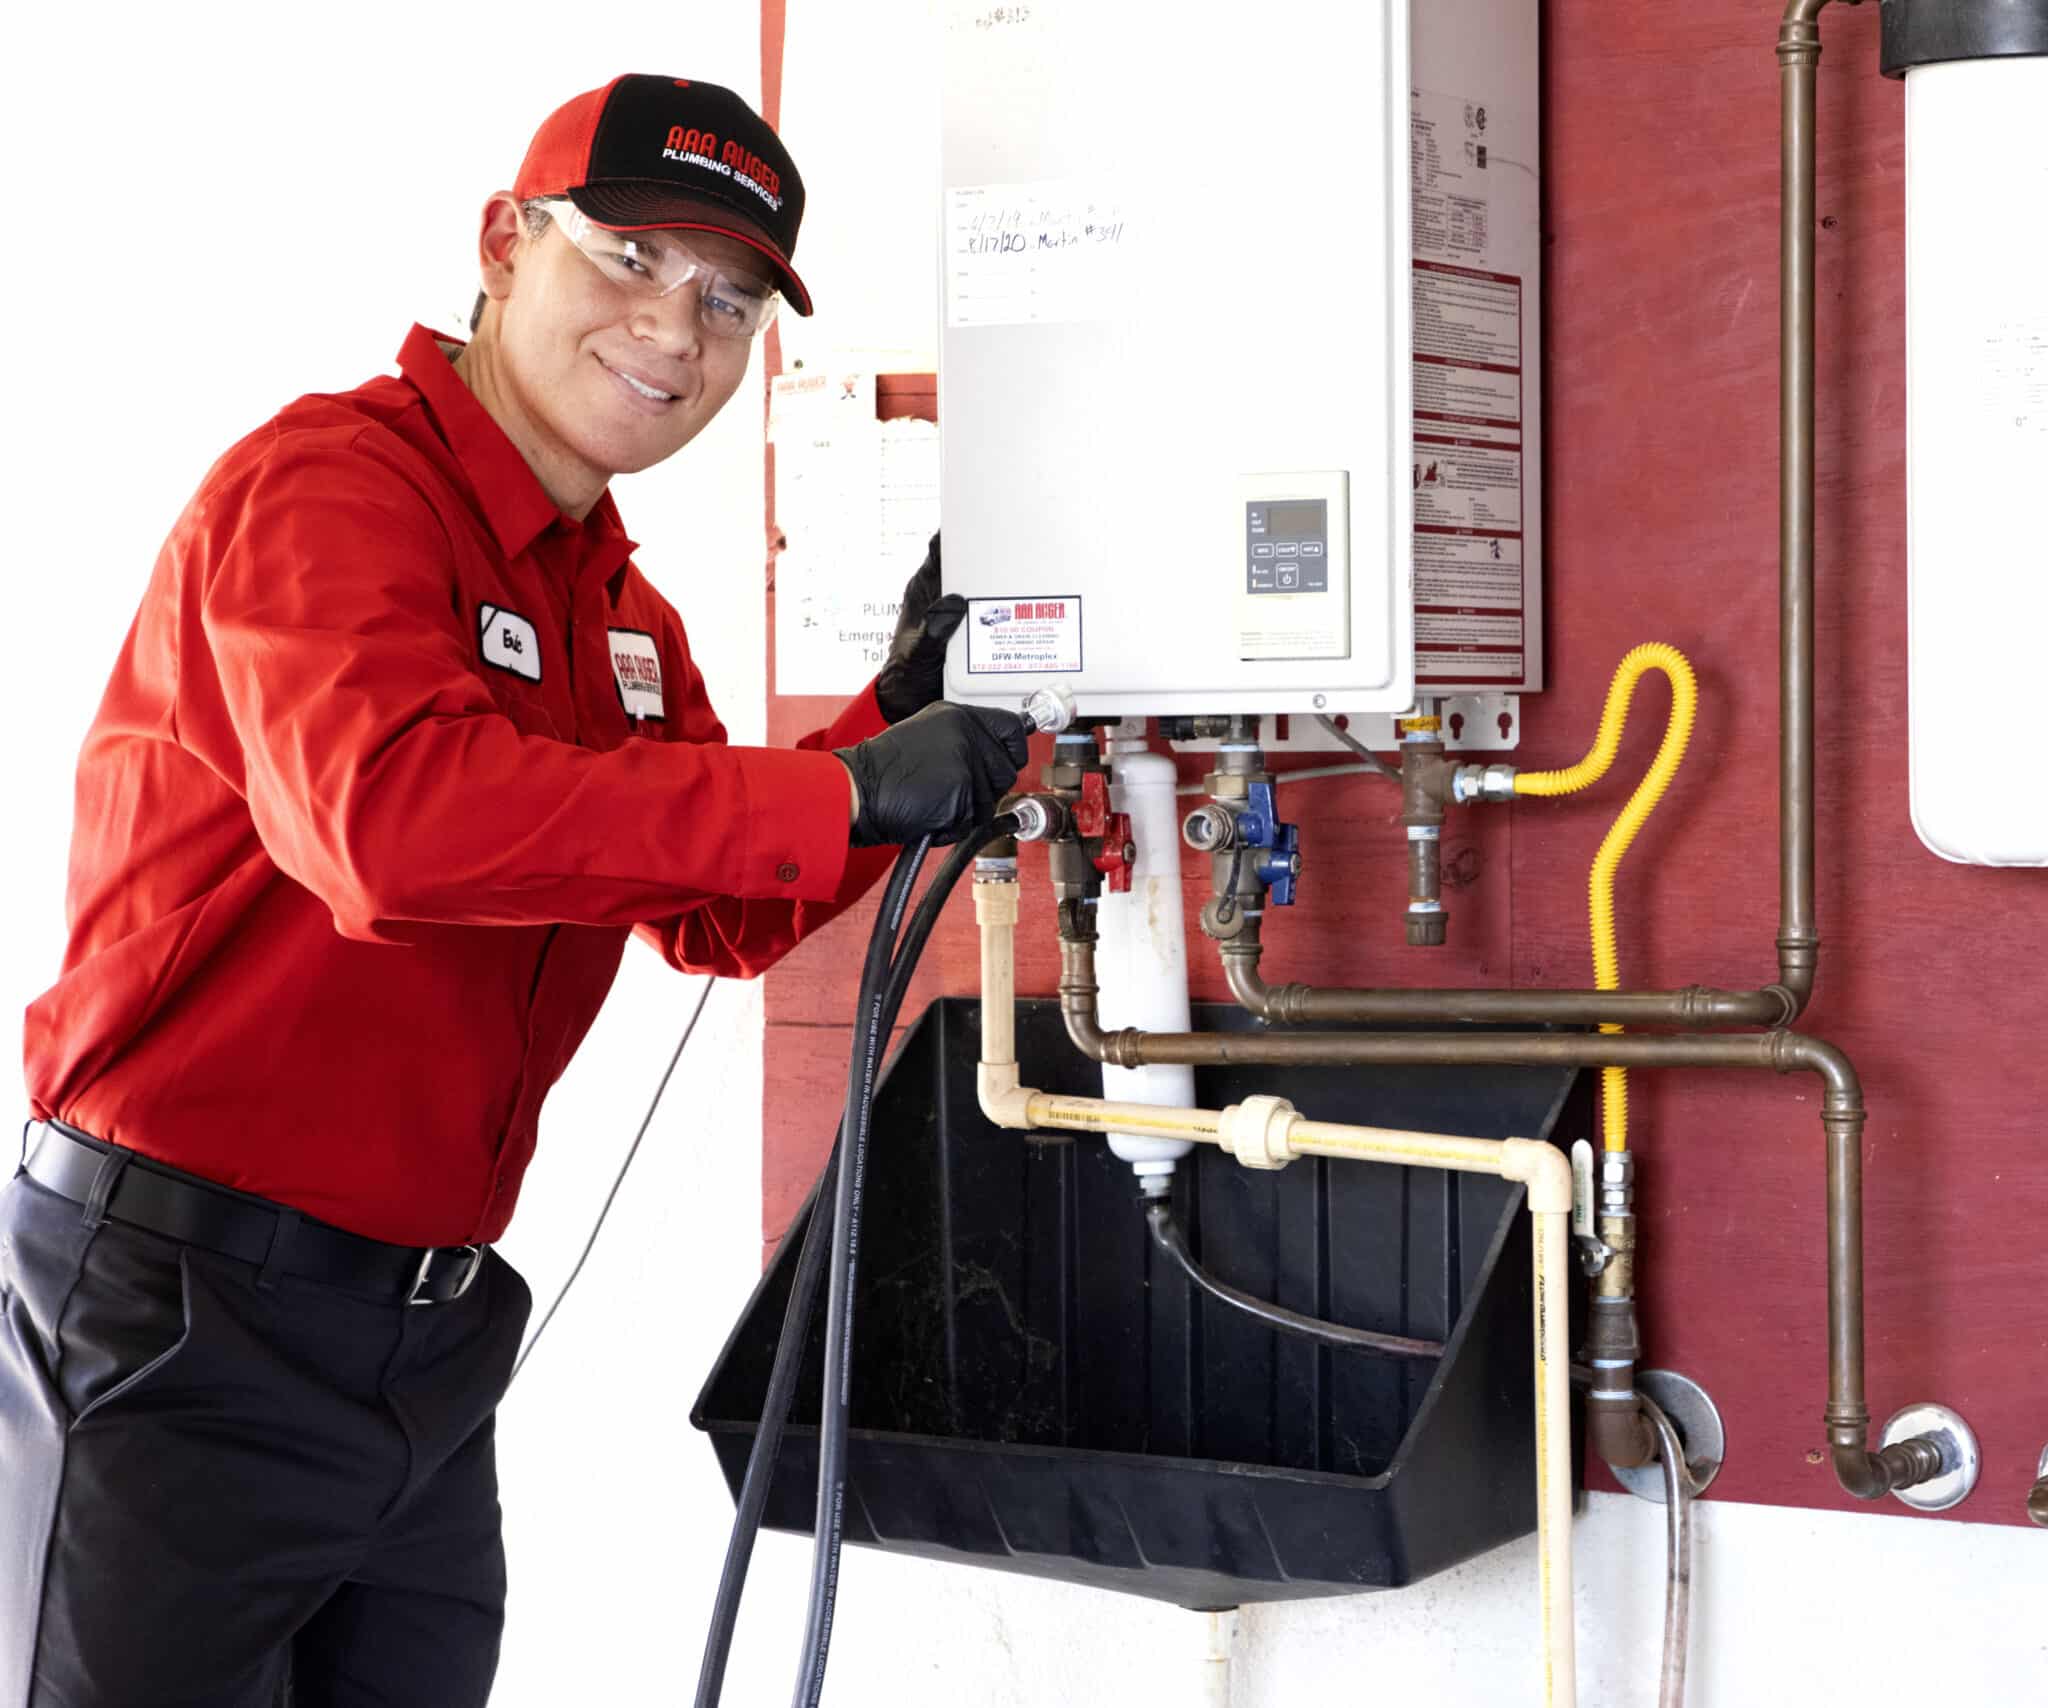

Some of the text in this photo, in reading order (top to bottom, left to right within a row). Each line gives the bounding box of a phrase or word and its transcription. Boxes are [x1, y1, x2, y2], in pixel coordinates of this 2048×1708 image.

[666, 125, 780, 198] AAA AUGER
[662, 148, 779, 212] PLUMBING SERVICES
[872, 1002, 881, 1018] FOR
[869, 1019, 879, 1035] USE
[867, 1036, 877, 1056] WITH
[864, 1057, 874, 1084] WATER
[863, 1084, 872, 1094] IN
[854, 1143, 866, 1188] LOCATIONS
[852, 1189, 861, 1210] ONLY
[834, 1491, 843, 1511] FOR
[832, 1512, 841, 1529] USE
[831, 1531, 840, 1554] WITH
